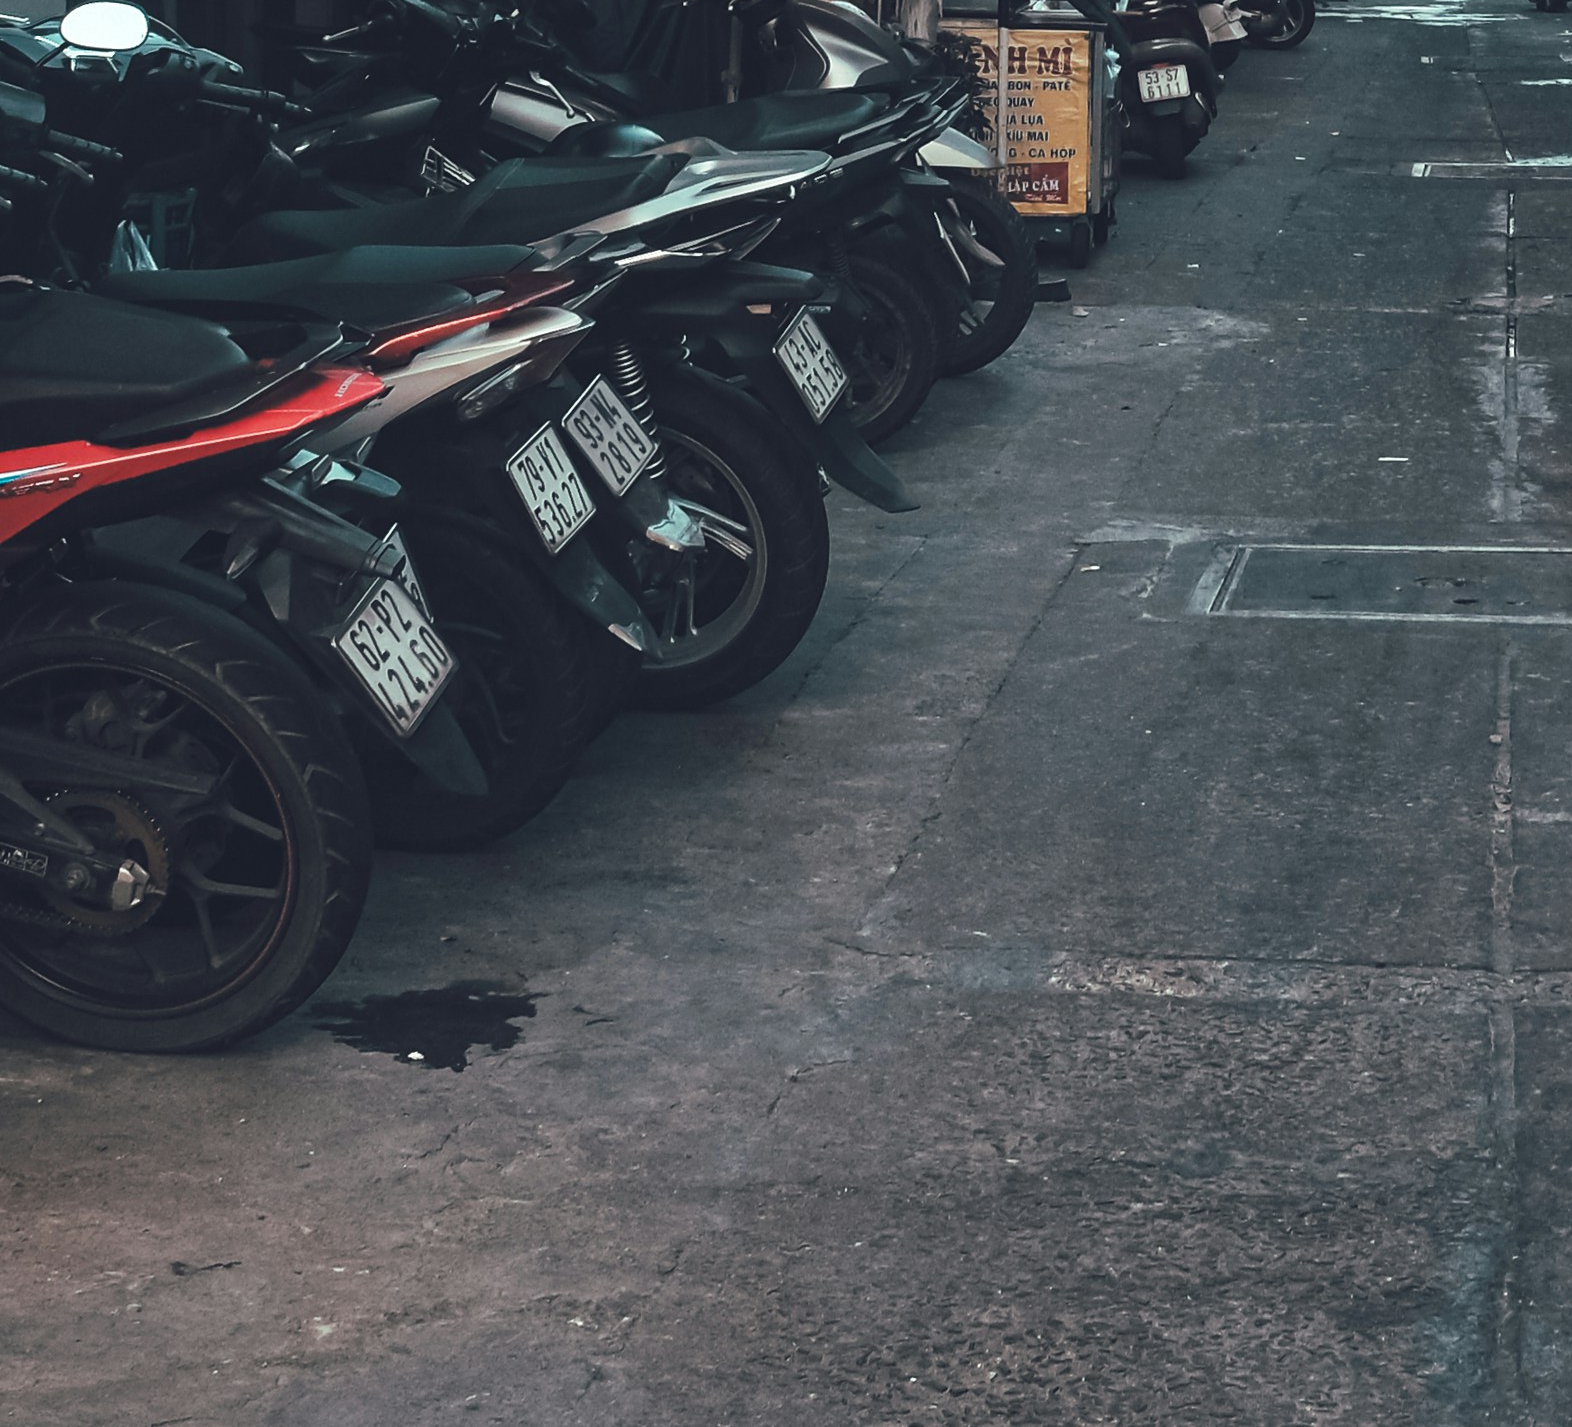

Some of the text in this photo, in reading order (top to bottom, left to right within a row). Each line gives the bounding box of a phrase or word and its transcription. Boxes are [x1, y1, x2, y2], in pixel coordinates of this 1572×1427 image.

[1147, 82, 1181, 99] 6111
[600, 421, 647, 487] 2819
[533, 472, 588, 545] 536.27
[350, 589, 413, 672] 62-P2
[377, 625, 449, 722] 424.60
